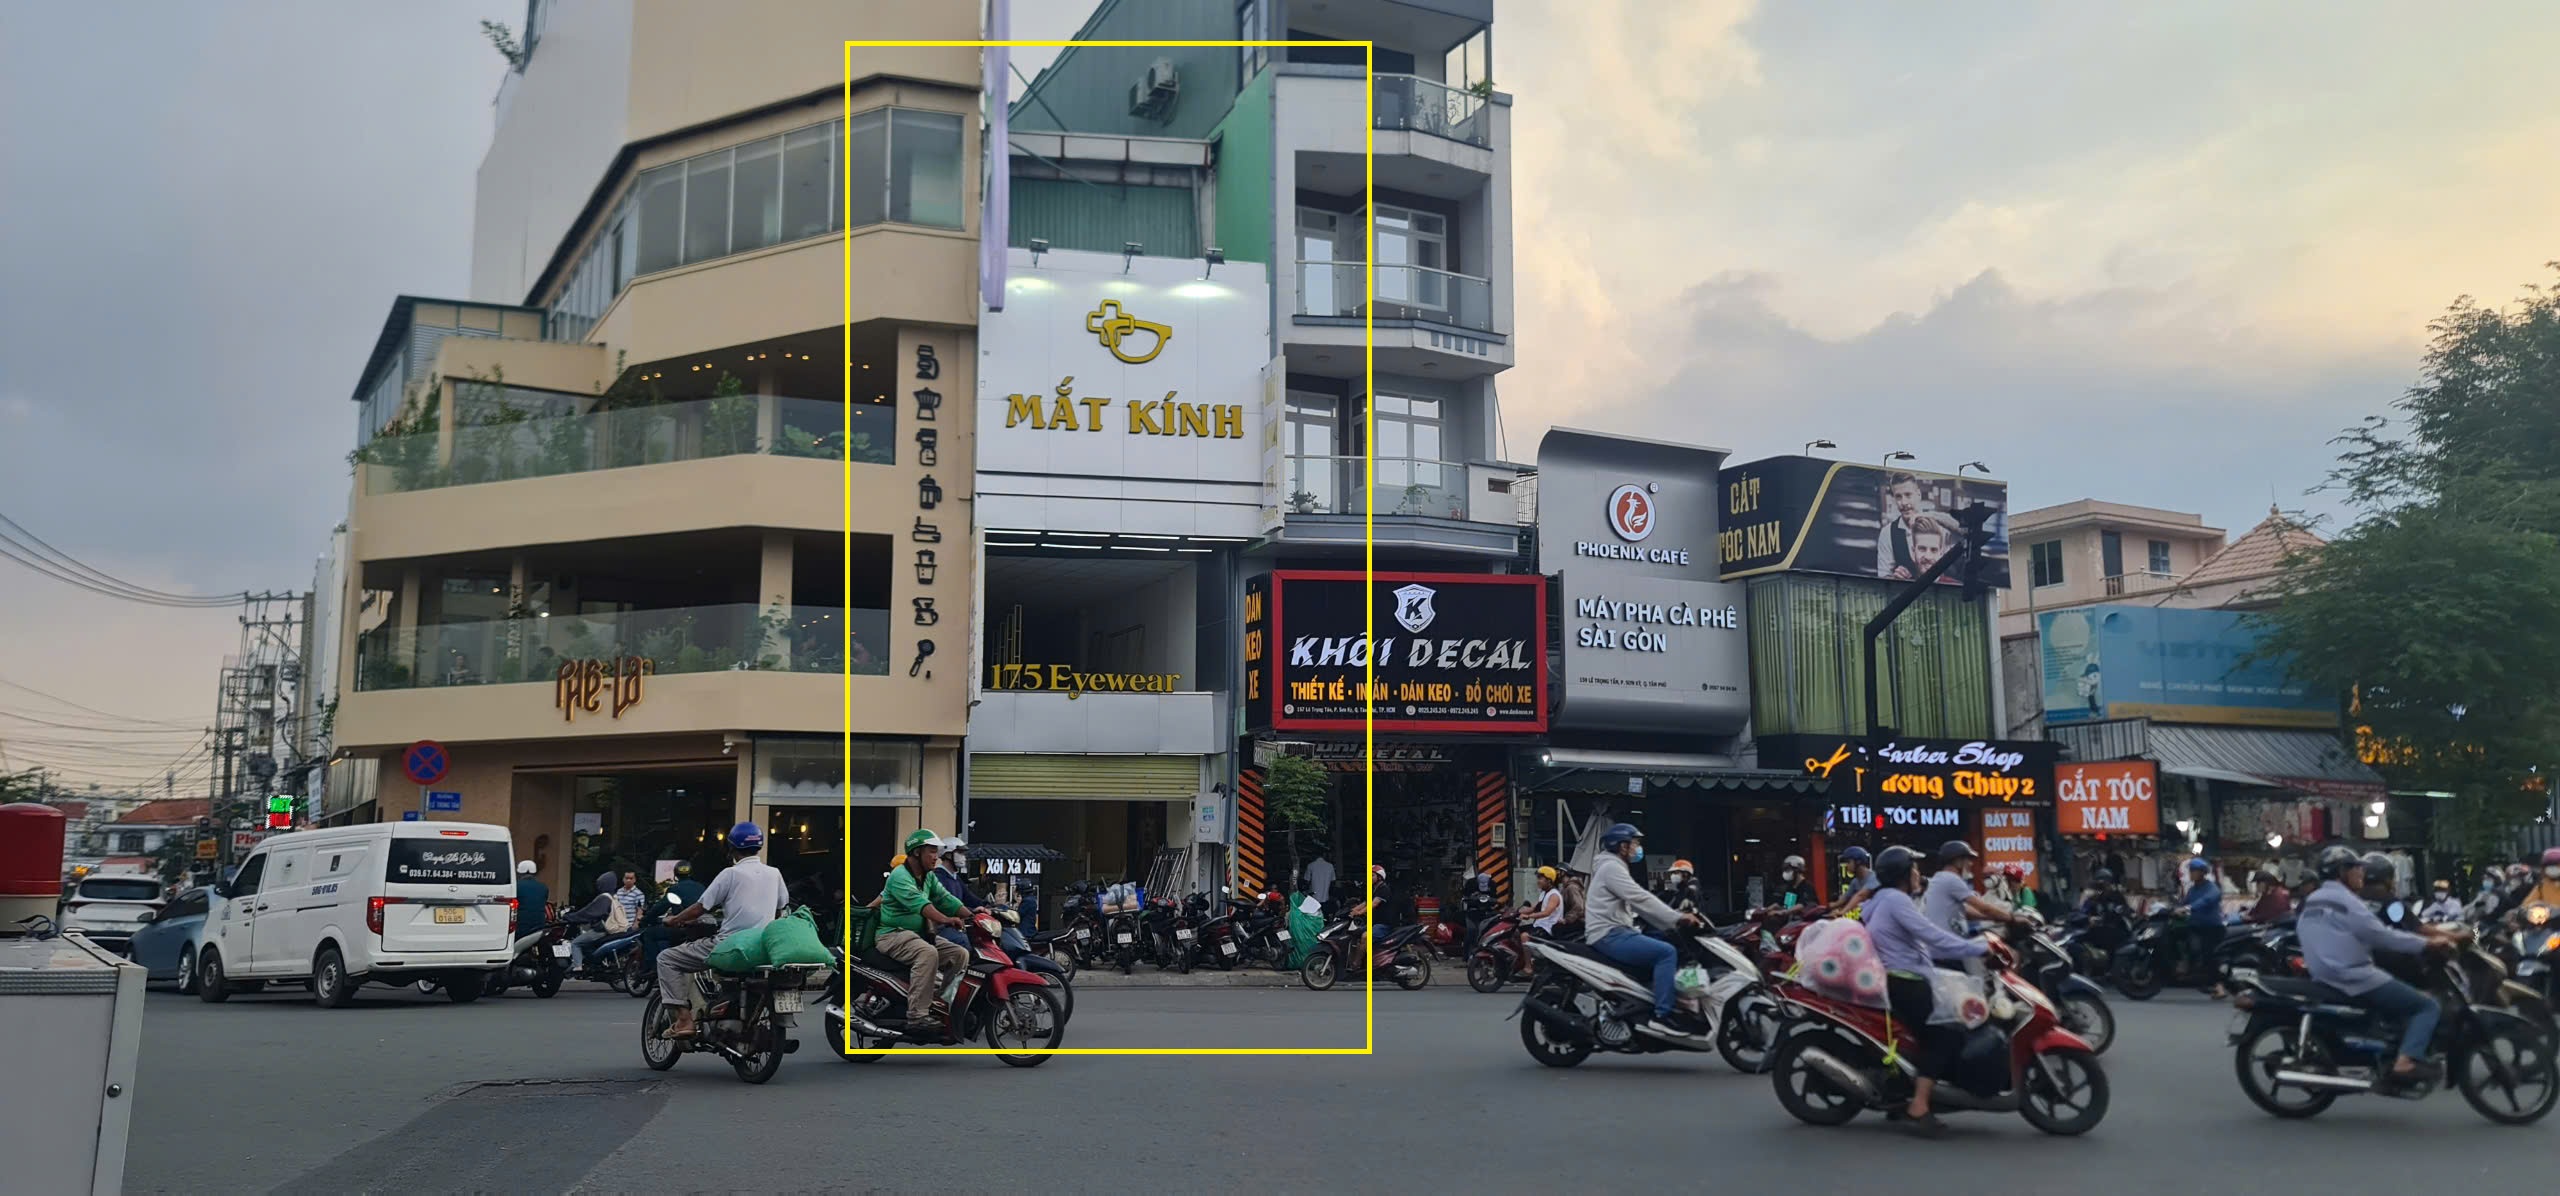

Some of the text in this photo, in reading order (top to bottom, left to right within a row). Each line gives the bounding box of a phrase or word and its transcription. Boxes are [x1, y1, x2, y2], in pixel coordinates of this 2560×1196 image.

[1006, 376, 1111, 431] MẮT
[1128, 391, 1244, 438] KÍNH
[1730, 472, 1760, 514] CẮT
[1577, 541, 1689, 564] PHOENIX CAFÉ
[1747, 520, 1781, 558] NAM
[1245, 584, 1261, 624] DÁN
[1579, 595, 1737, 629] MÁY PHA CÀ PHÊ
[1246, 629, 1262, 661] KEO
[1289, 632, 1533, 671] KHÔI DECAL
[1579, 623, 1667, 652] SÀI GÒN
[991, 663, 1182, 700] 175 Eyewear
[1248, 669, 1259, 700] XE
[1291, 674, 1325, 700] THIẾT
[1328, 674, 1345, 700] KẾ
[1400, 680, 1424, 701] DÁN
[1428, 683, 1452, 701] KEO
[1466, 677, 1481, 702] ĐỒ
[1486, 682, 1513, 703] CHƠI
[1517, 685, 1532, 703] XE
[1953, 742, 2024, 772] Shop
[1951, 770, 2019, 802] Thùy
[2021, 778, 2035, 795] 2
[2058, 768, 2152, 801] CẮT TÓC
[1920, 808, 1959, 825] NAM
[2010, 813, 2030, 827] TAI
[2081, 806, 2130, 830] NAM
[986, 858, 1041, 874] Xôi Xá Xíu
